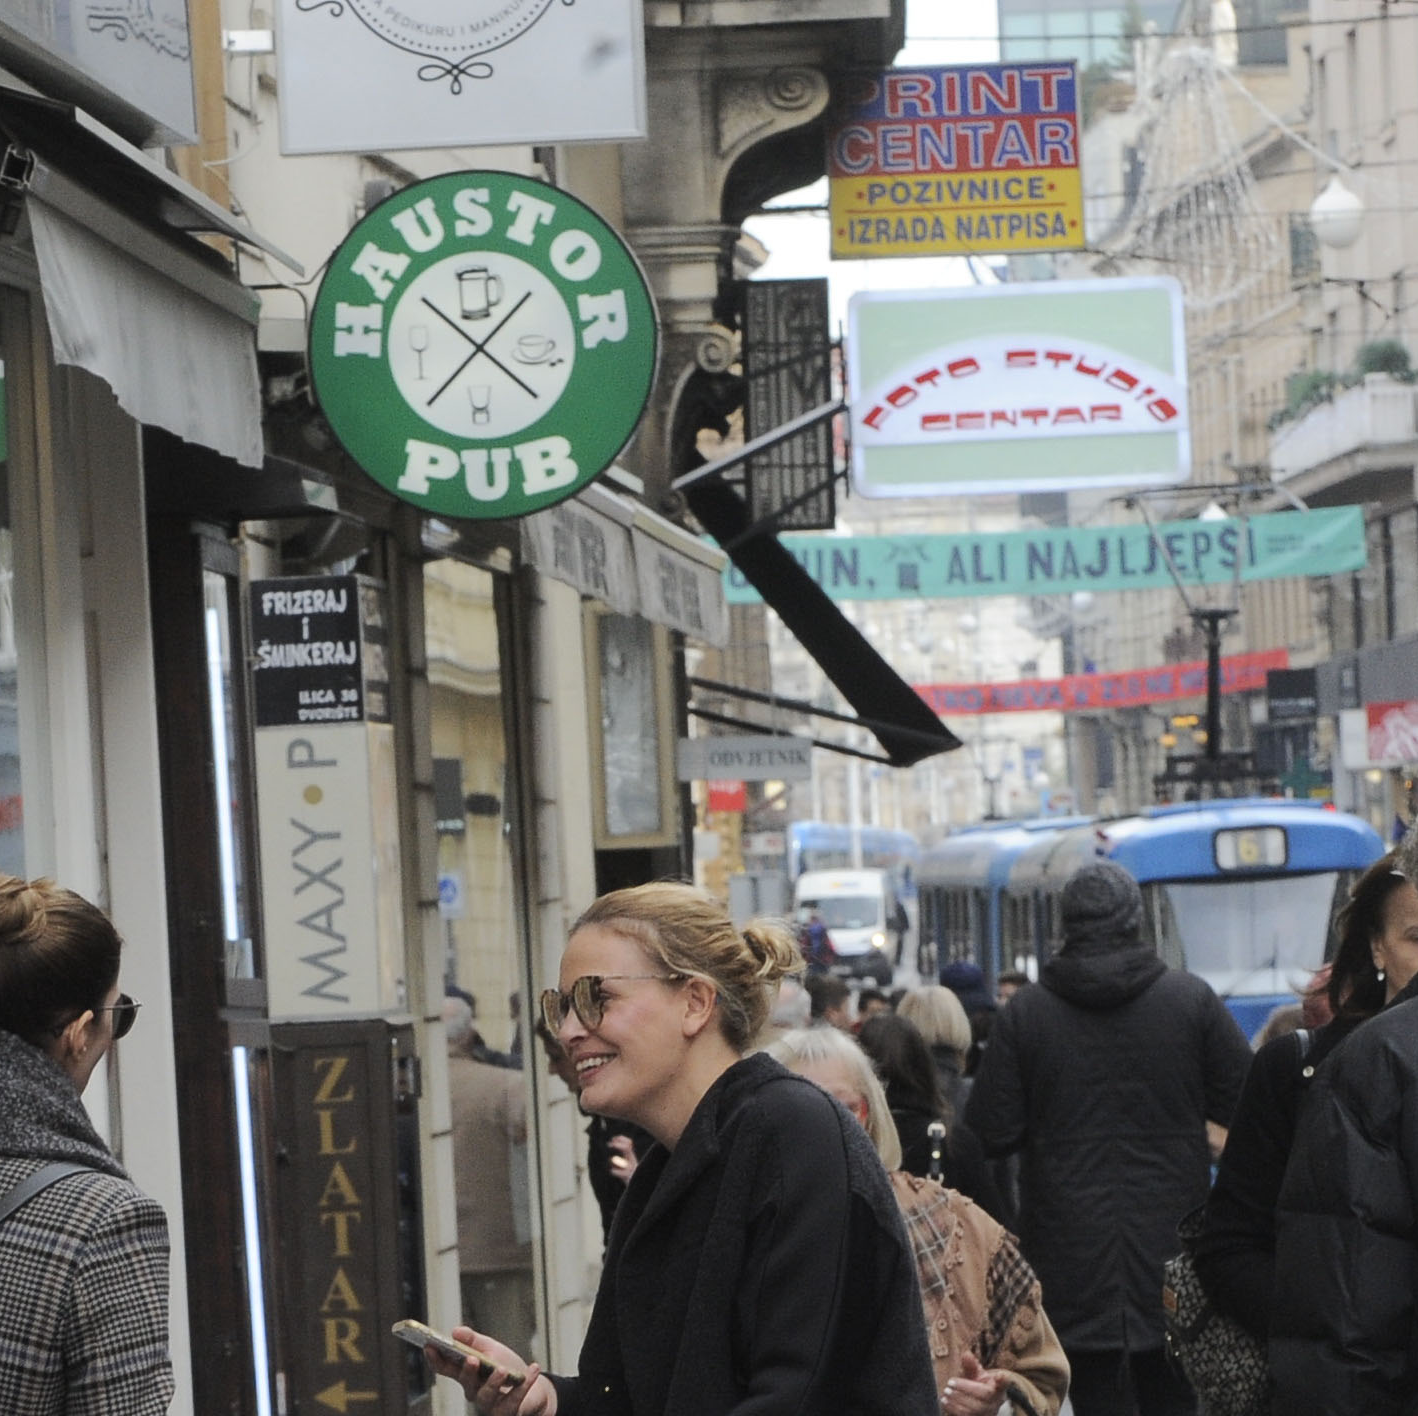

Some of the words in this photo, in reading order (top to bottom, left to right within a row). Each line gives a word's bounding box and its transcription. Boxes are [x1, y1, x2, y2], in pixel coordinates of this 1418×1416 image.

[384, 7, 454, 37] PEDIKURU
[855, 68, 1072, 118] RINT
[835, 118, 1076, 174] CENTAR
[867, 177, 1046, 205] POZIVNICE
[848, 216, 946, 244] IZRADA
[956, 212, 1067, 240] NATPISA
[333, 188, 629, 357] HAUSTOR
[863, 357, 980, 430] FOTO
[1005, 350, 1178, 422] STUDIO
[921, 404, 1122, 431] CENTAR
[397, 436, 579, 501] PUB
[947, 542, 1006, 584] ALI
[262, 588, 347, 615] FRIZERAJ
[709, 750, 806, 766] ODVJETNIK
[1238, 832, 1259, 862] 6
[290, 818, 349, 1004] MAXY
[312, 1055, 365, 1364] ZLATAR
